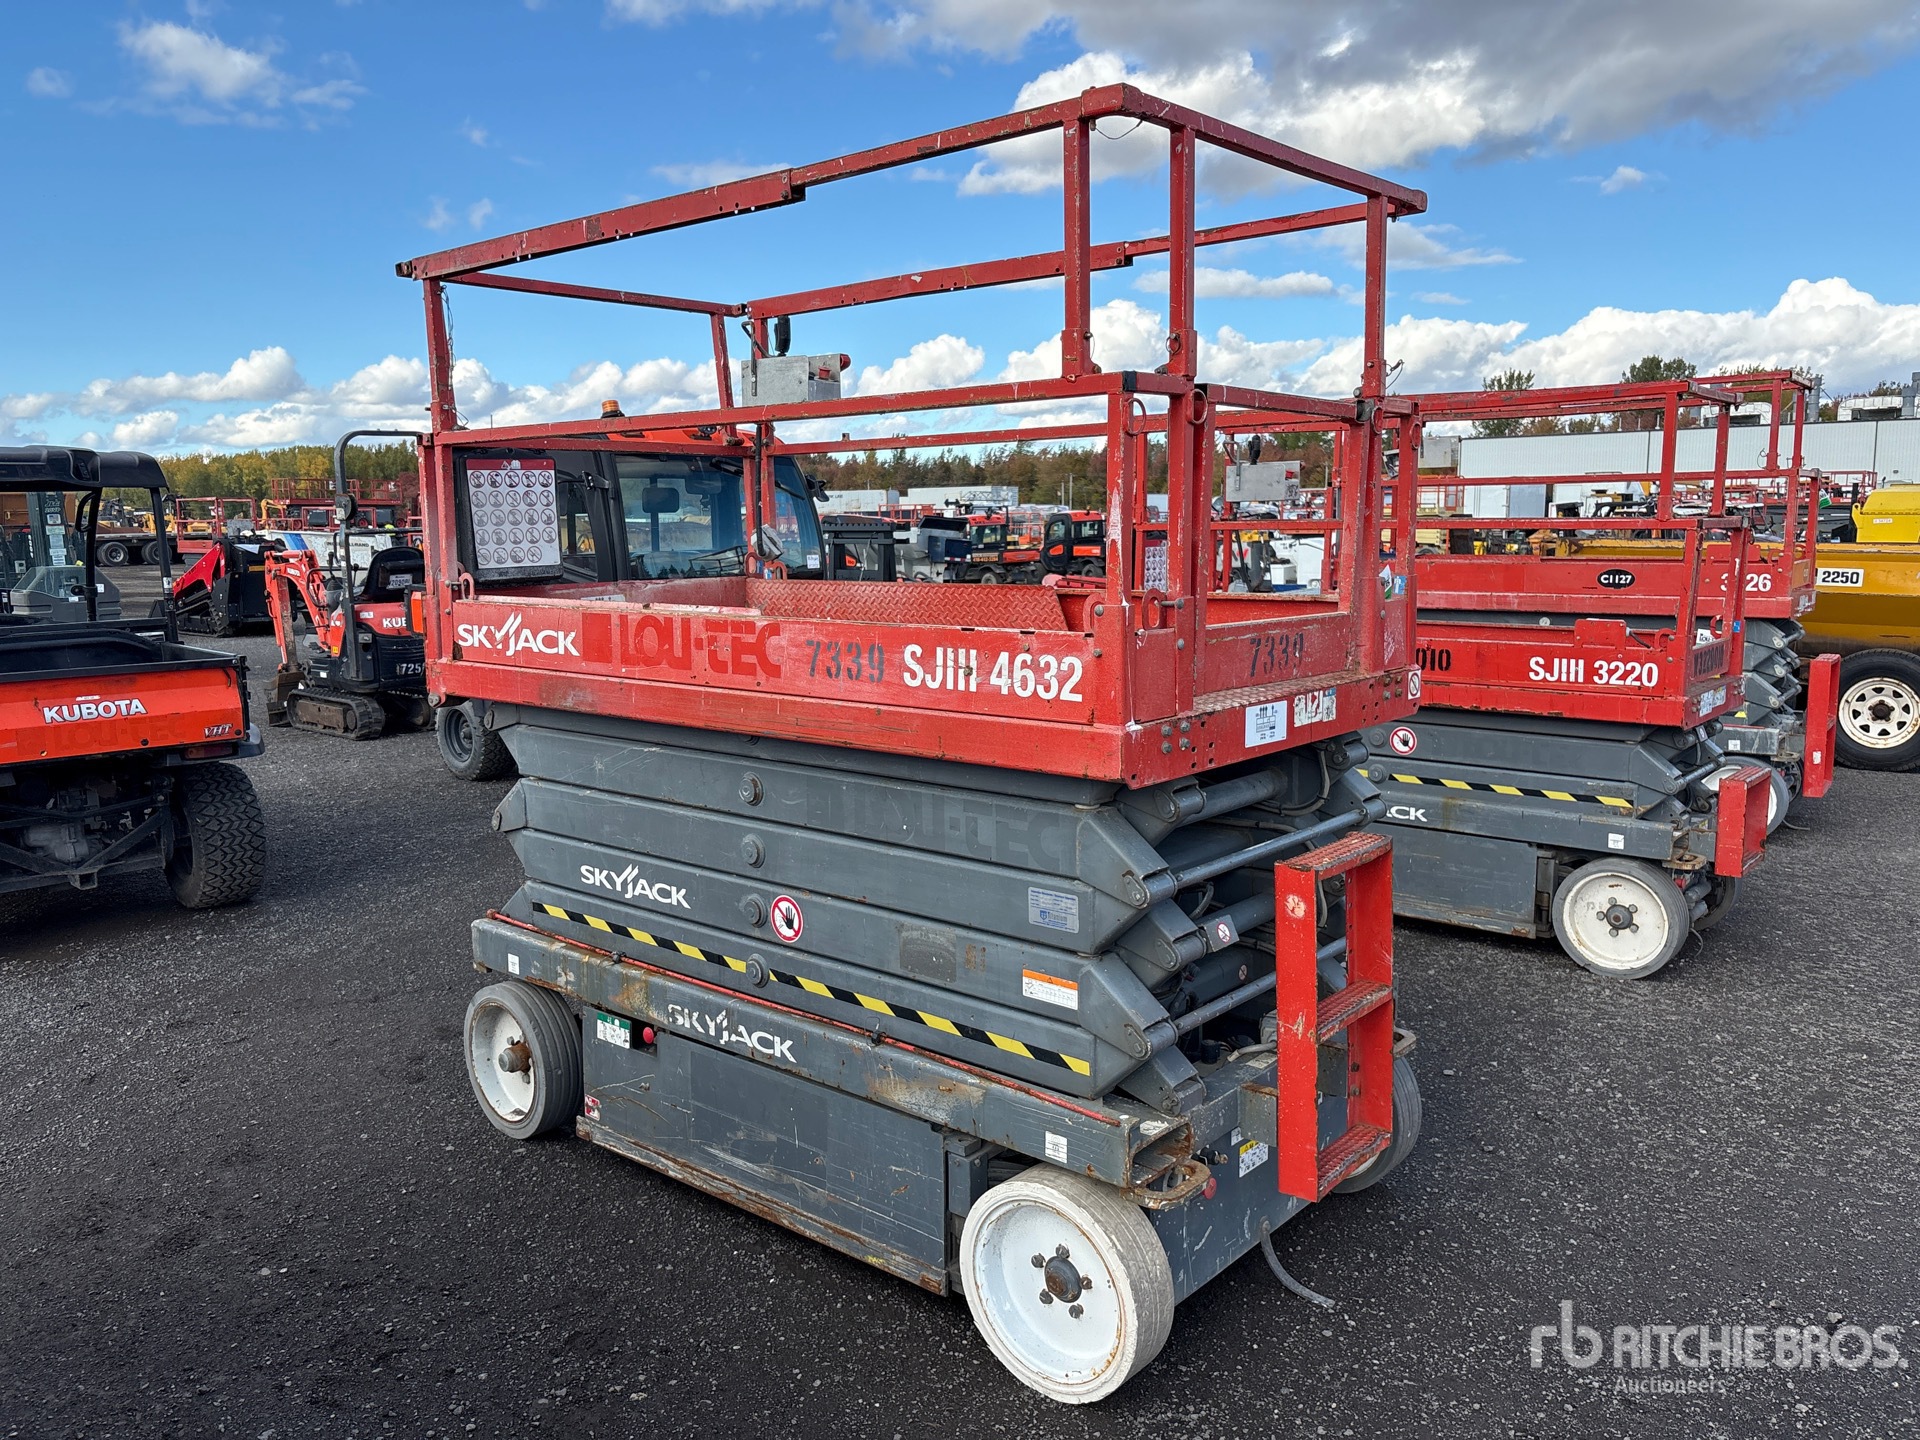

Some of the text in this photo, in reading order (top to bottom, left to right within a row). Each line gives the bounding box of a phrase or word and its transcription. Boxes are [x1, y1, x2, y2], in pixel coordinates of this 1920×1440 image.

[1720, 573, 1772, 592] 326
[1821, 570, 1860, 585] 2250
[457, 611, 581, 657] SKYJACK
[806, 640, 885, 684] 7339
[989, 651, 1083, 702] 4632
[1593, 659, 1659, 689] 3220
[43, 698, 148, 724] KUBOTA
[580, 864, 692, 909] SKYJACK
[667, 1003, 798, 1064] SKYJACK
